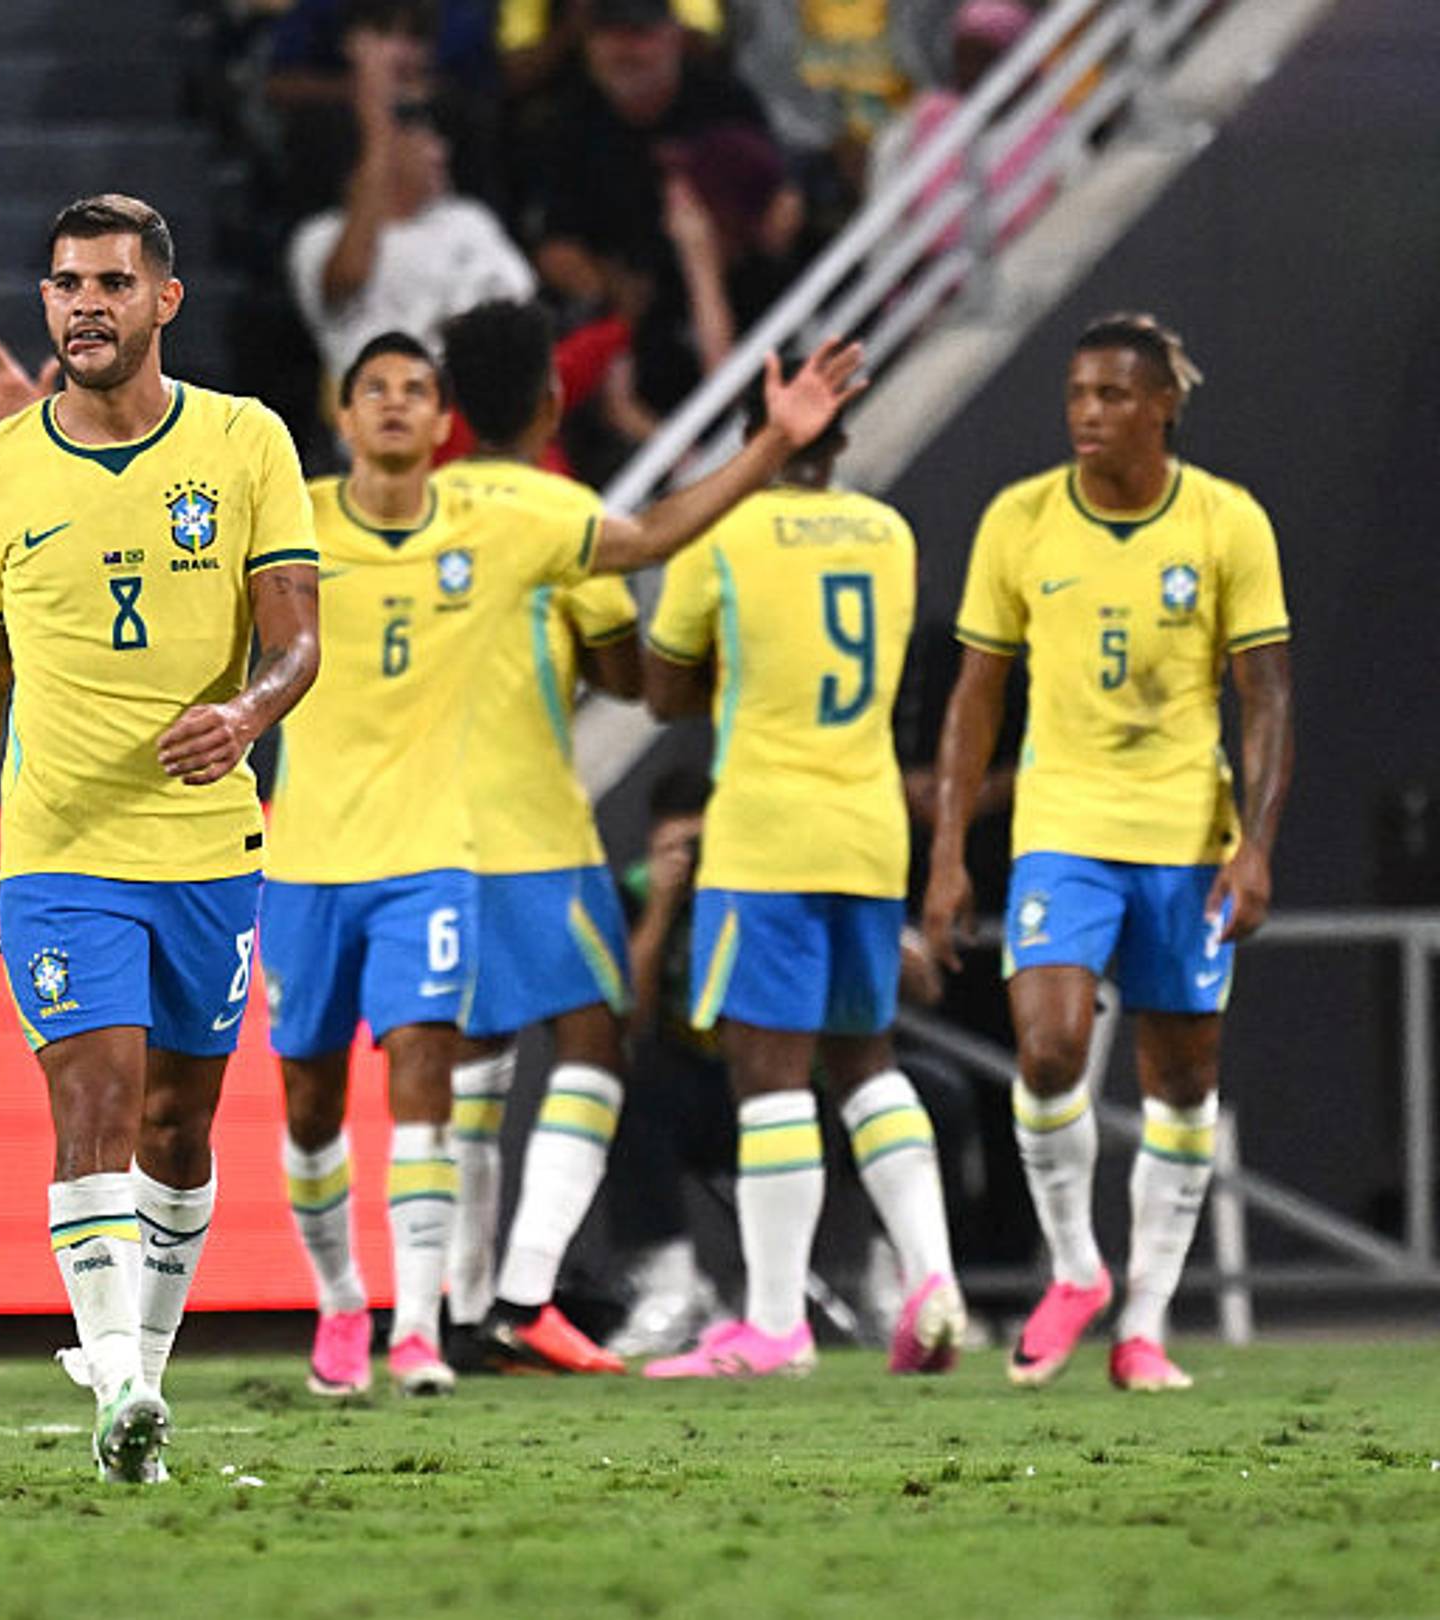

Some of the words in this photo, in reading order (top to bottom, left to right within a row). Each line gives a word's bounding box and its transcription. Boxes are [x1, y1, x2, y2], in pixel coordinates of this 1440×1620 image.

[171, 557, 221, 572] BRASIL
[110, 576, 148, 651] 8
[382, 617, 411, 678] 6
[816, 572, 875, 728] 9
[1101, 629, 1128, 690] 5
[228, 927, 255, 1003] 8
[427, 907, 459, 973] 6
